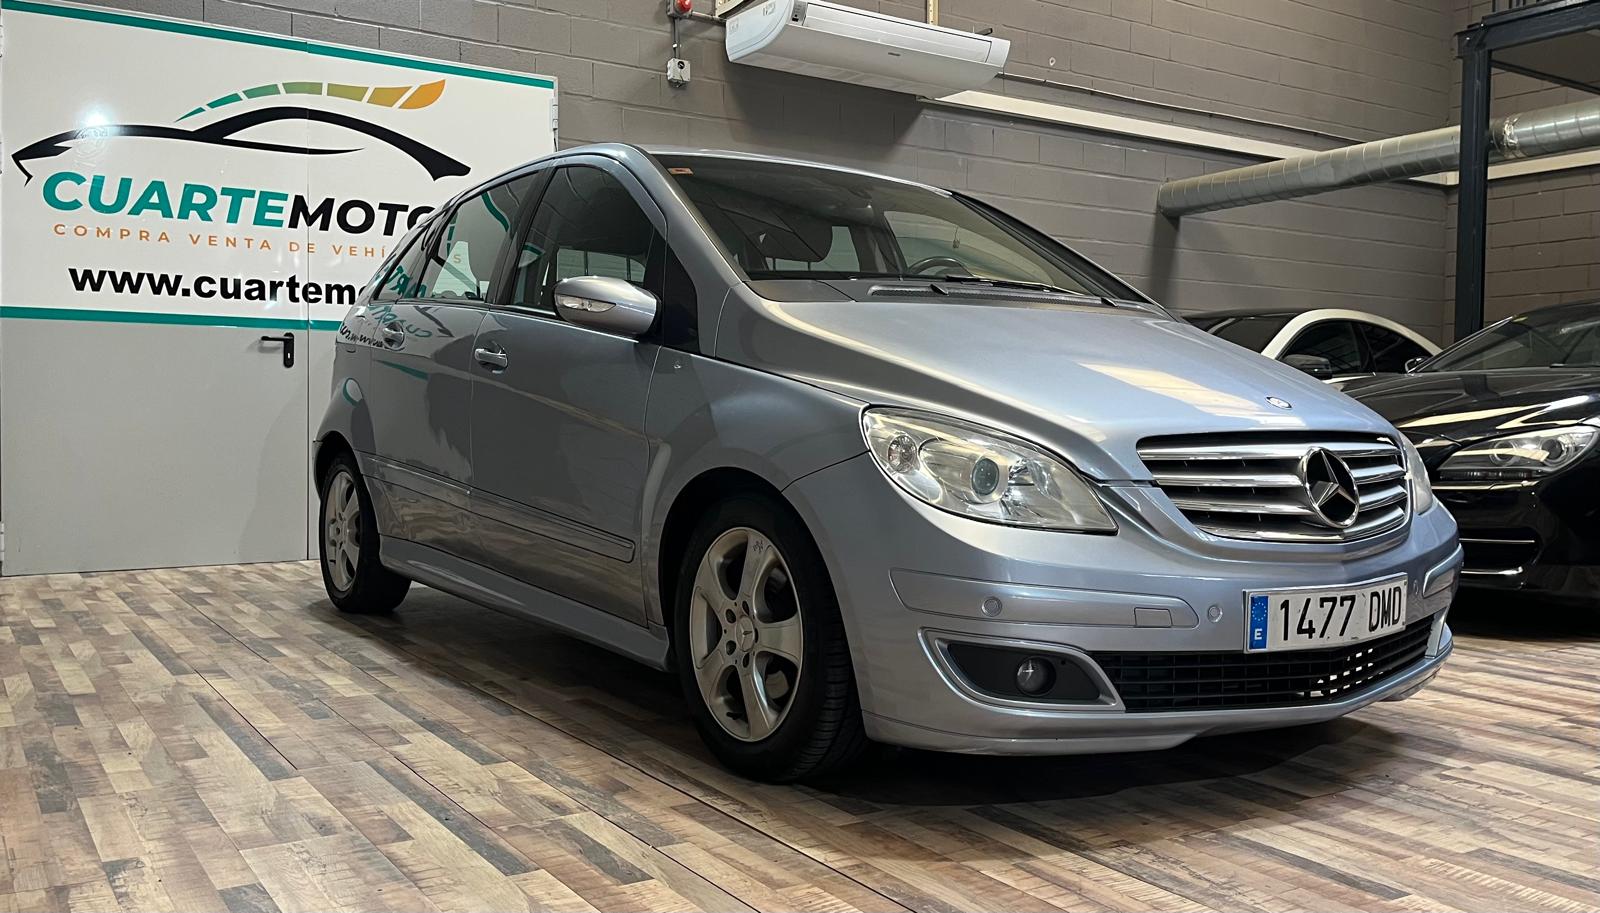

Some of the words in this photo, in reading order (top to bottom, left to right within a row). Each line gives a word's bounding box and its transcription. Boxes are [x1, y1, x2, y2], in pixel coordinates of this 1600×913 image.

[52, 223, 170, 243] COMPRA
[188, 234, 273, 251] VENTA
[287, 241, 317, 254] DE
[68, 267, 366, 305] www.cuartem
[1280, 594, 1357, 642] 1477
[1368, 586, 1402, 633] DMD
[1254, 628, 1263, 640] E
